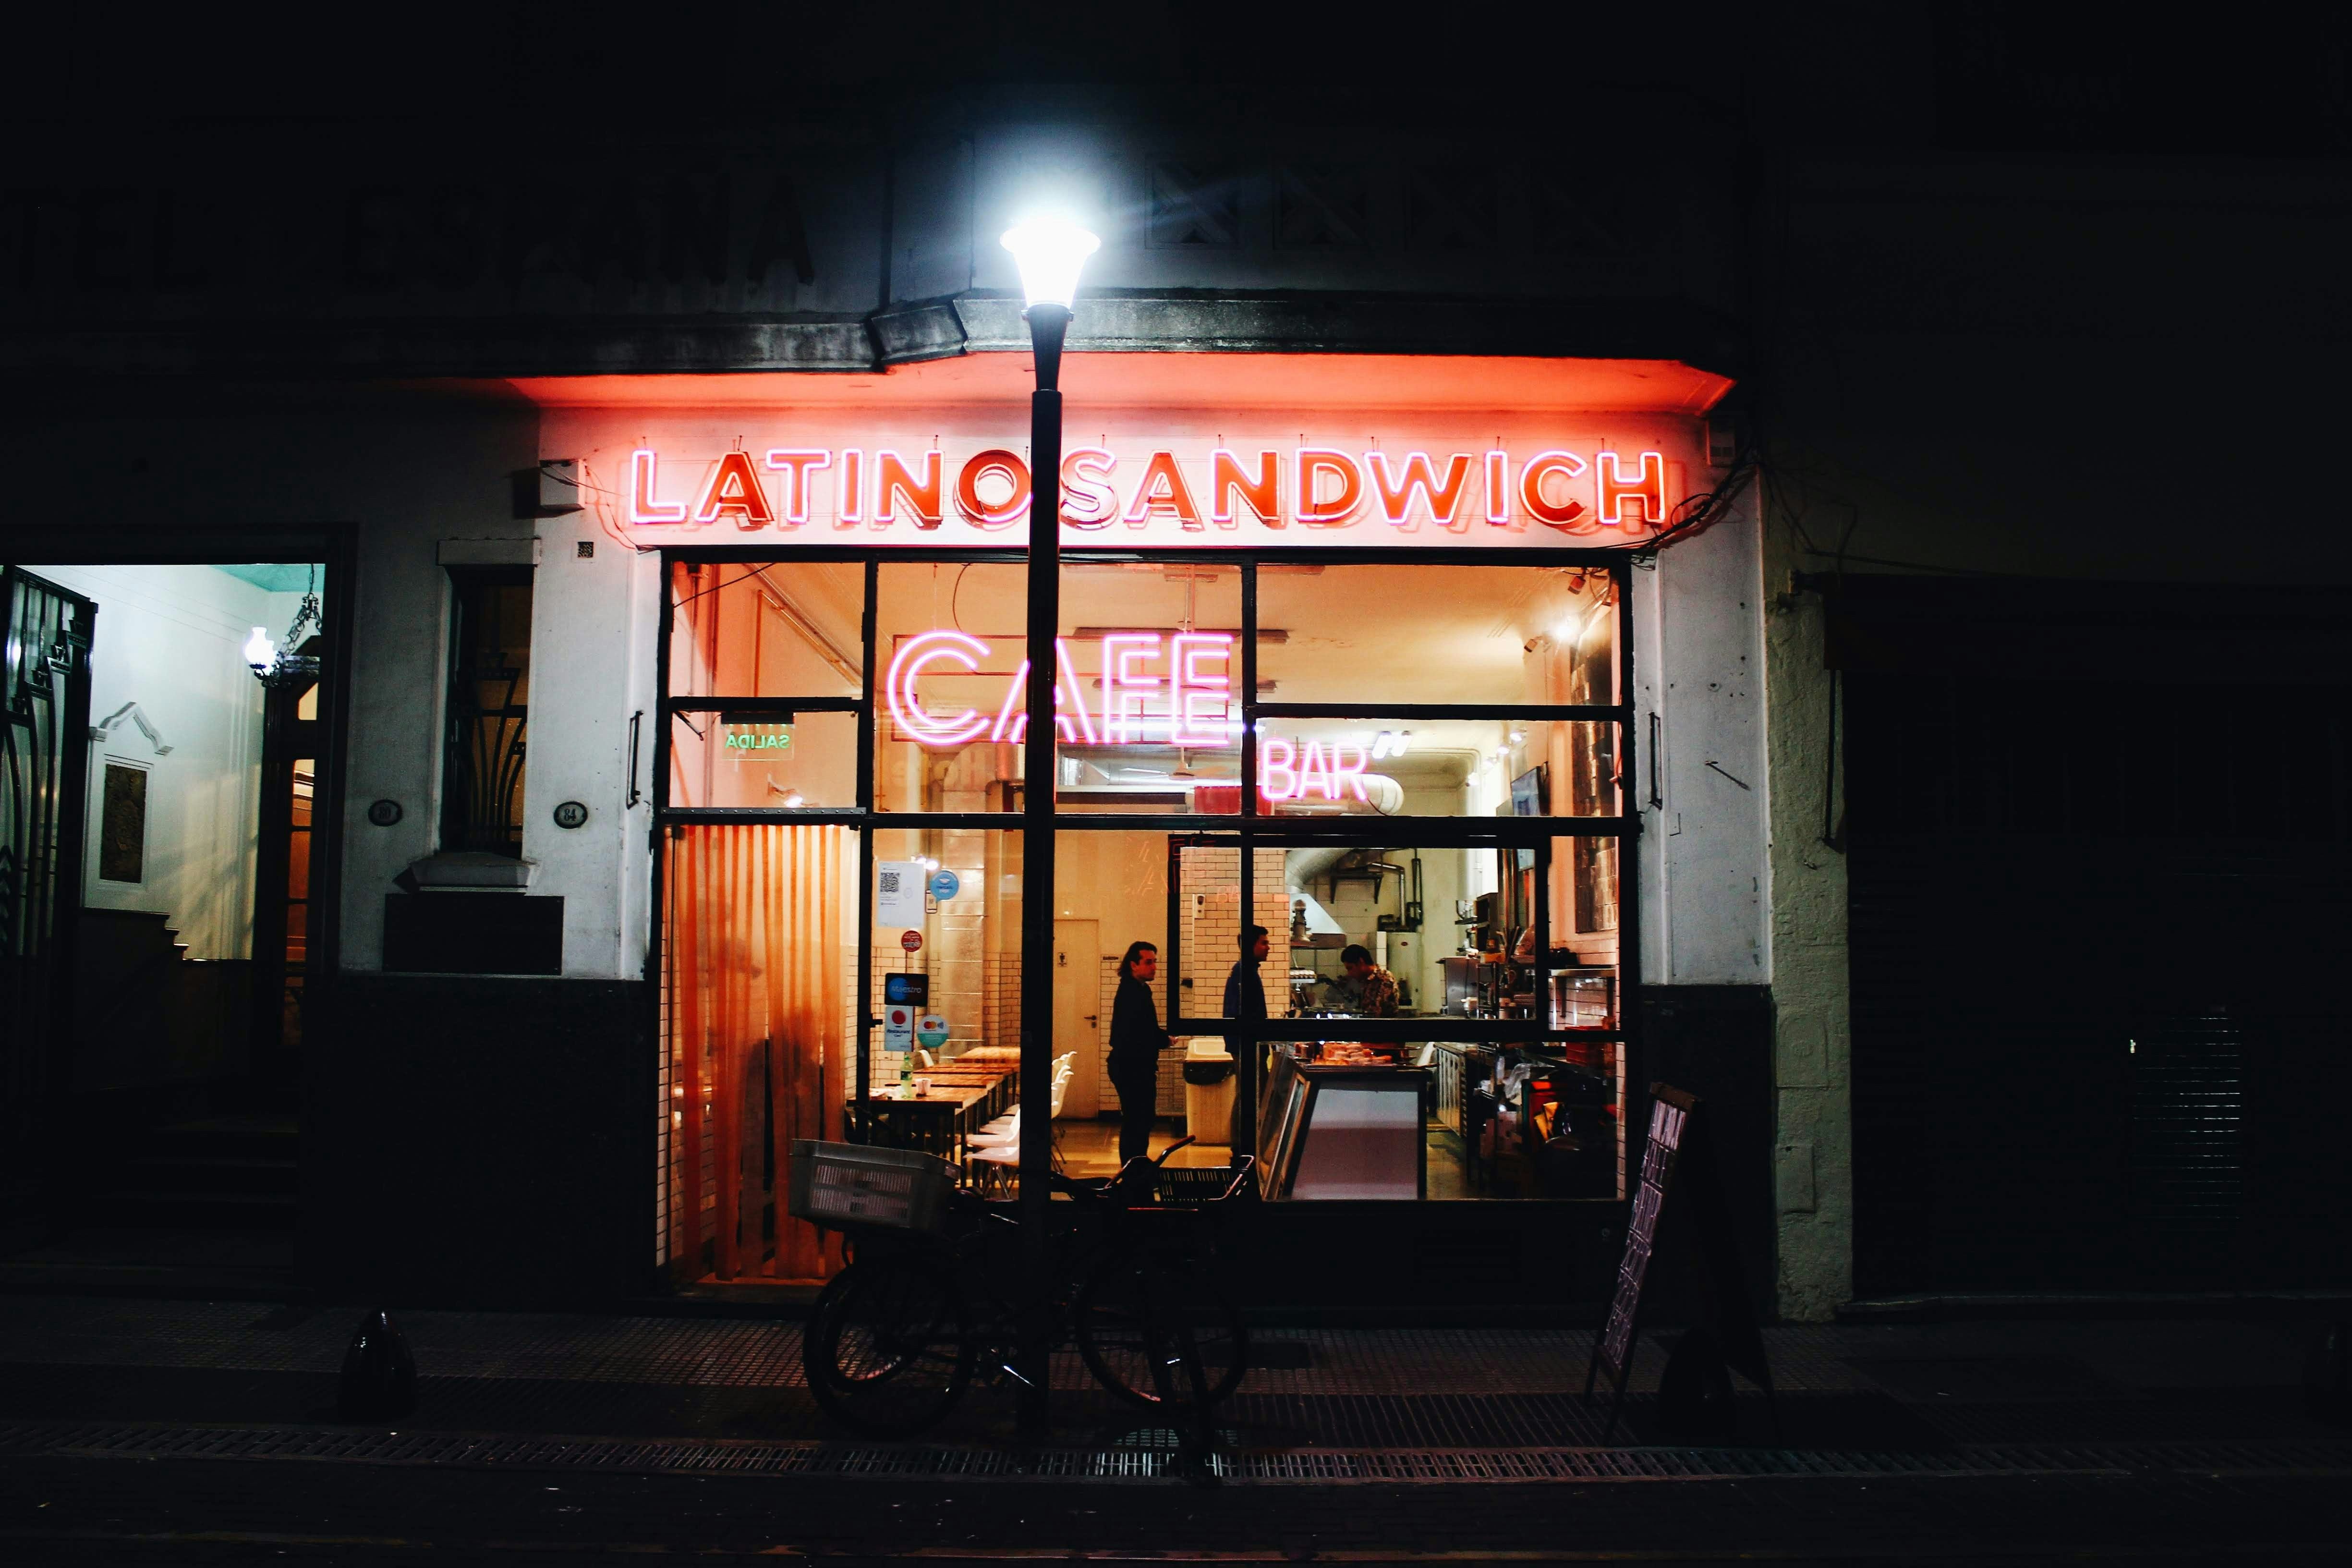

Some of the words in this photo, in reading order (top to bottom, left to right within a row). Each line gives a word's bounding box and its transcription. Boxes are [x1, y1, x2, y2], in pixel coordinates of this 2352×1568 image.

[630, 447, 1032, 524] LATINO
[1060, 446, 1667, 526] SANDWICH
[887, 629, 1233, 746] CAFE
[1259, 738, 1369, 802] BAR
[564, 808, 576, 821] 84
